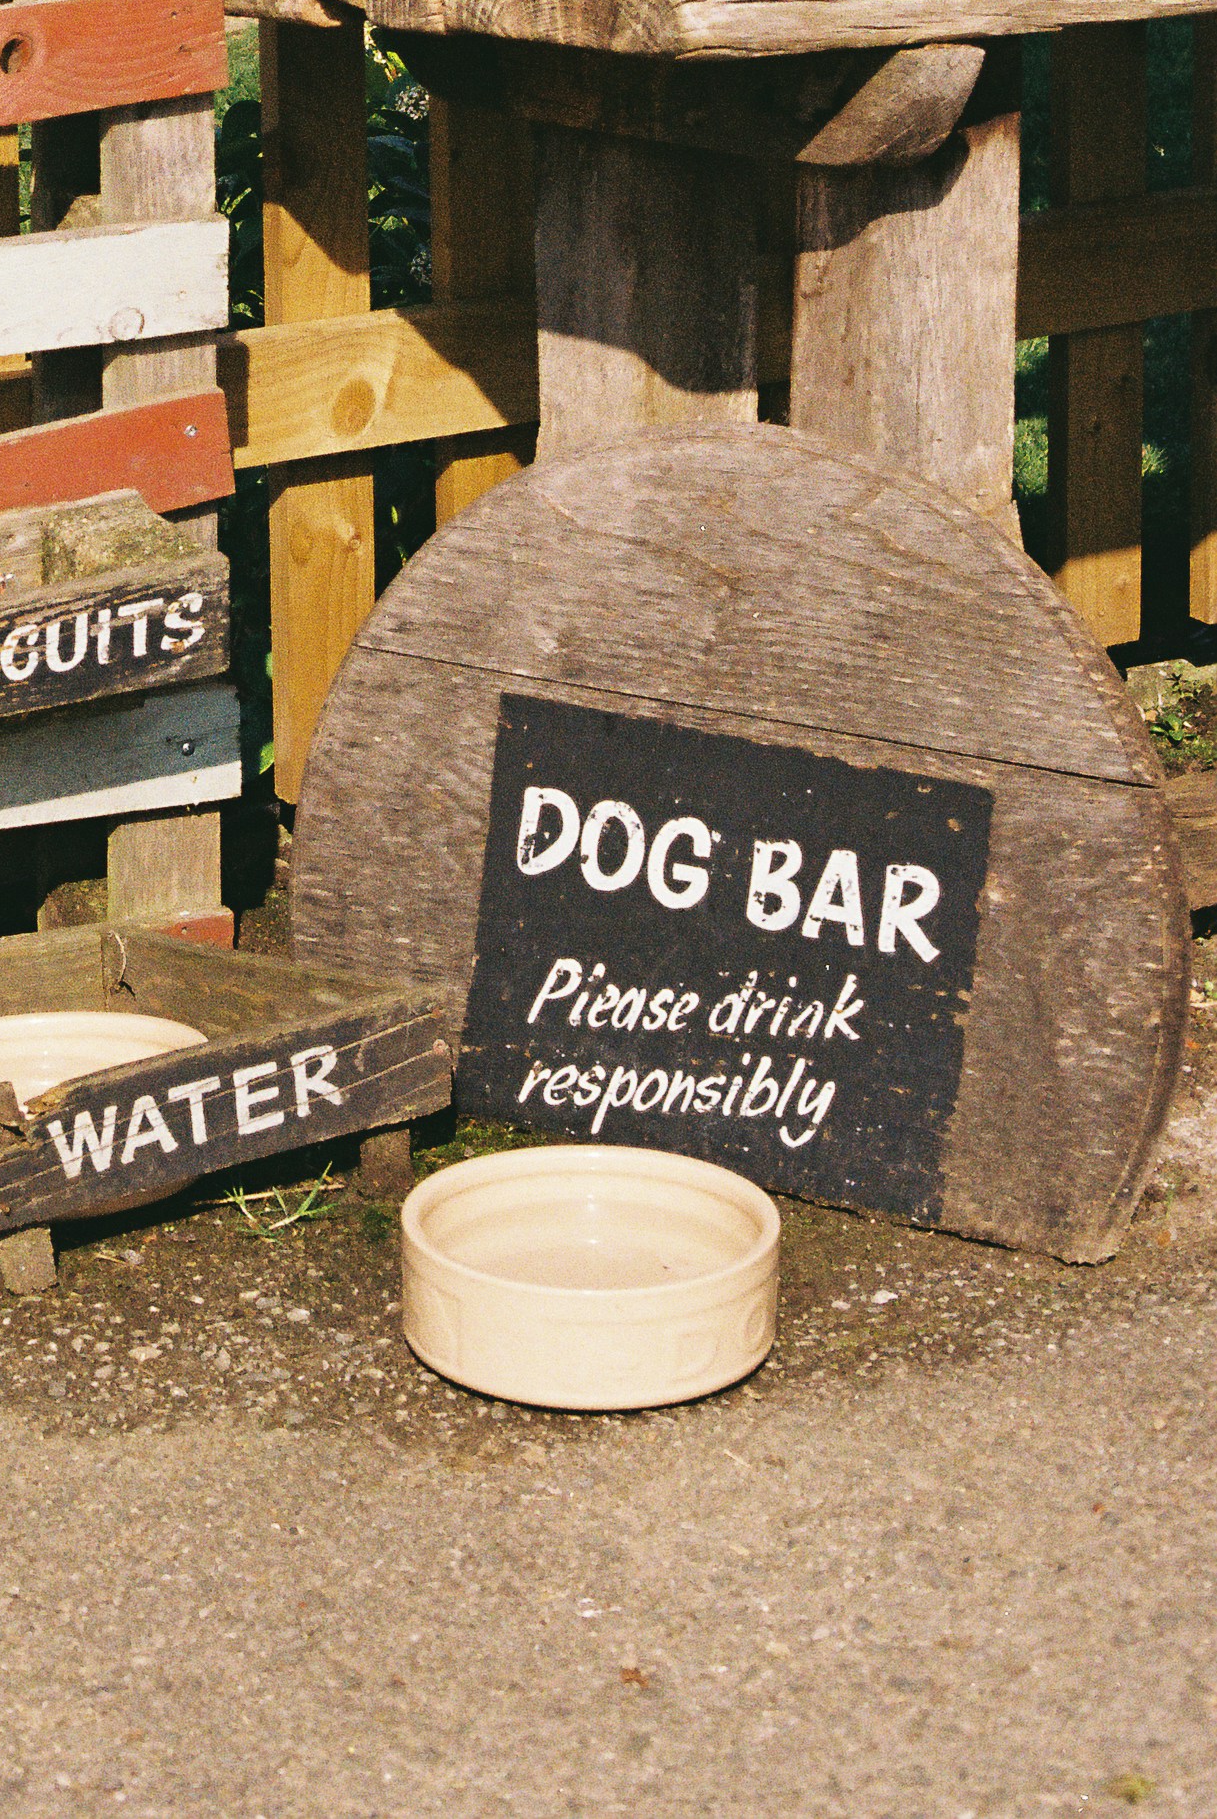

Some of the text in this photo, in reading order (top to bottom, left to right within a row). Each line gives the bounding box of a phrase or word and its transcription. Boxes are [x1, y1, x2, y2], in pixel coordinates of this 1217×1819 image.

[516, 785, 942, 964] DOG BAR
[527, 957, 865, 1041] Please drink
[45, 1044, 344, 1180] WATER
[517, 1052, 837, 1148] responsibly
